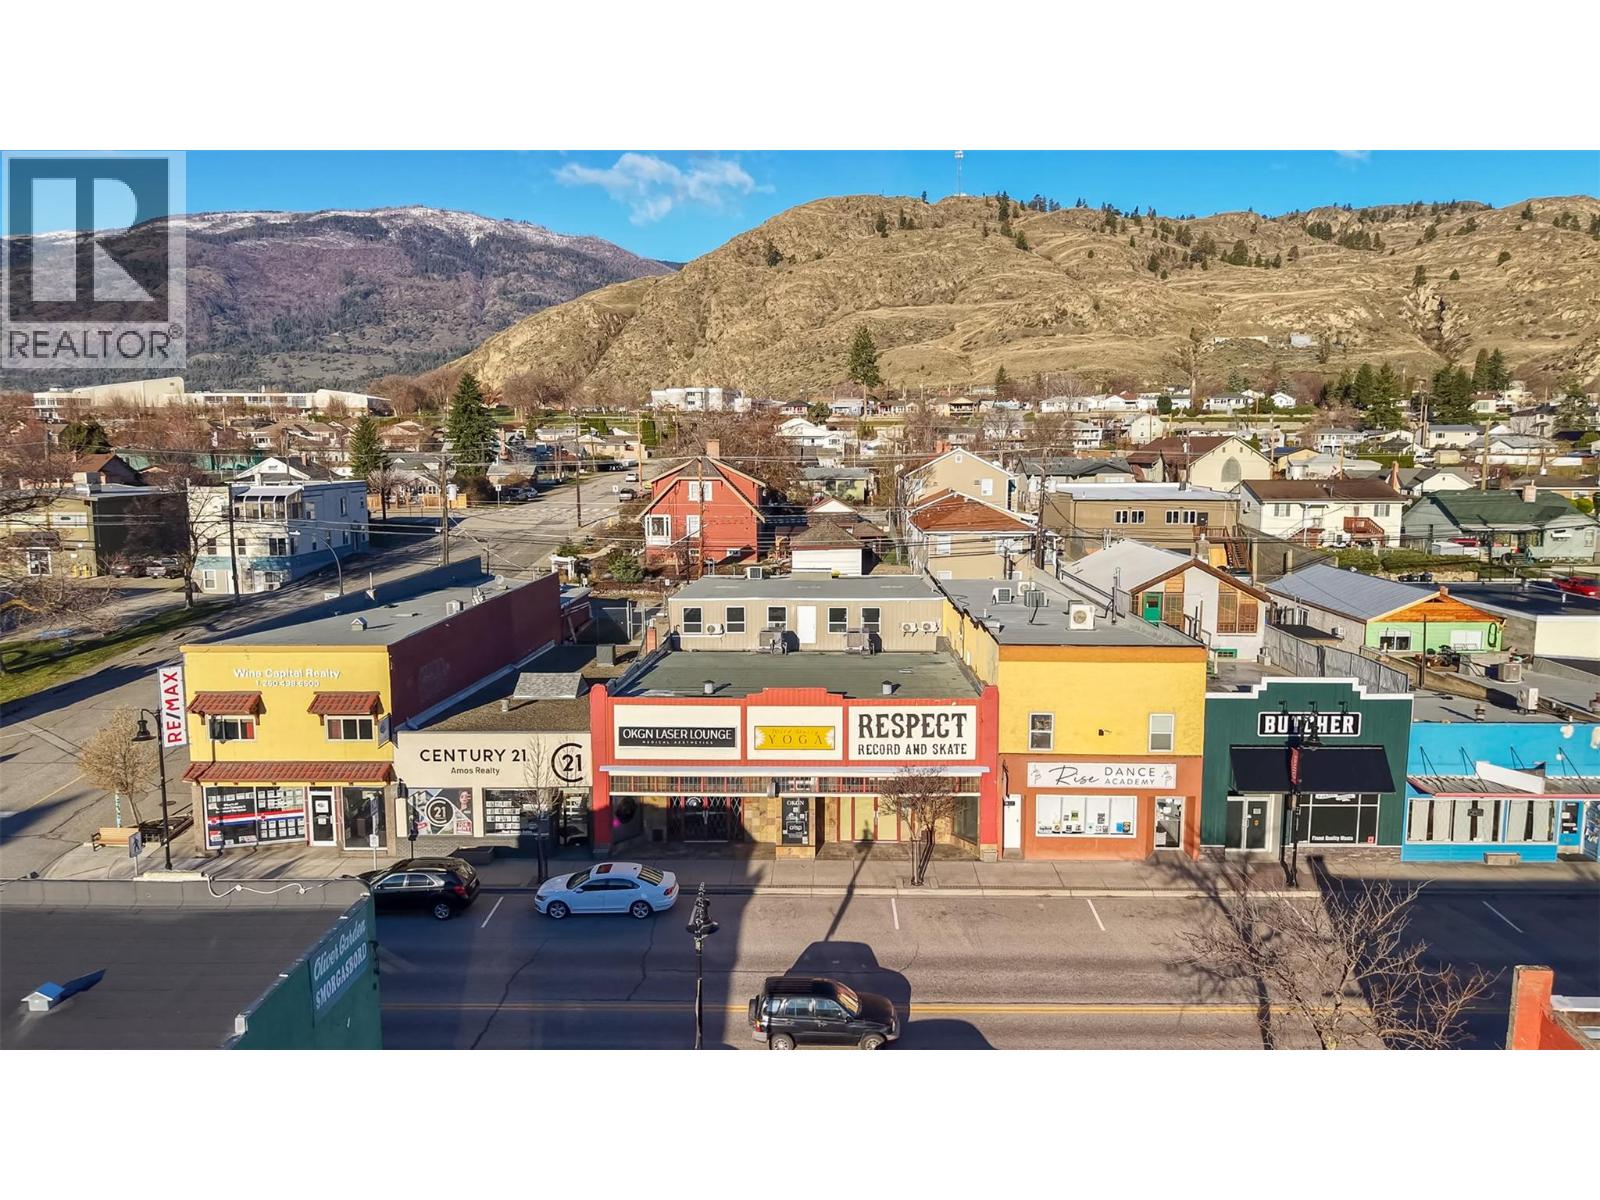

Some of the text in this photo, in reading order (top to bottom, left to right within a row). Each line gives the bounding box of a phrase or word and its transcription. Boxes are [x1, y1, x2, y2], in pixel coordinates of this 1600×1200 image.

[265, 667, 303, 680] Capital
[305, 667, 341, 679] Realty
[163, 671, 183, 743] RE/MAX
[858, 713, 967, 739] RESPECT
[622, 728, 733, 740] OKGN LASER LOUNGE
[768, 734, 823, 745] YOGA
[419, 749, 506, 762] CENTURY
[858, 743, 967, 755] RECORD AND SKATE
[450, 767, 500, 776] Amos Realty
[1049, 764, 1156, 786] Rise DANCE
[1104, 778, 1156, 786] ACADEMY
[312, 919, 367, 981] Oliver Garden
[315, 941, 368, 1010] SMORGASBORD
